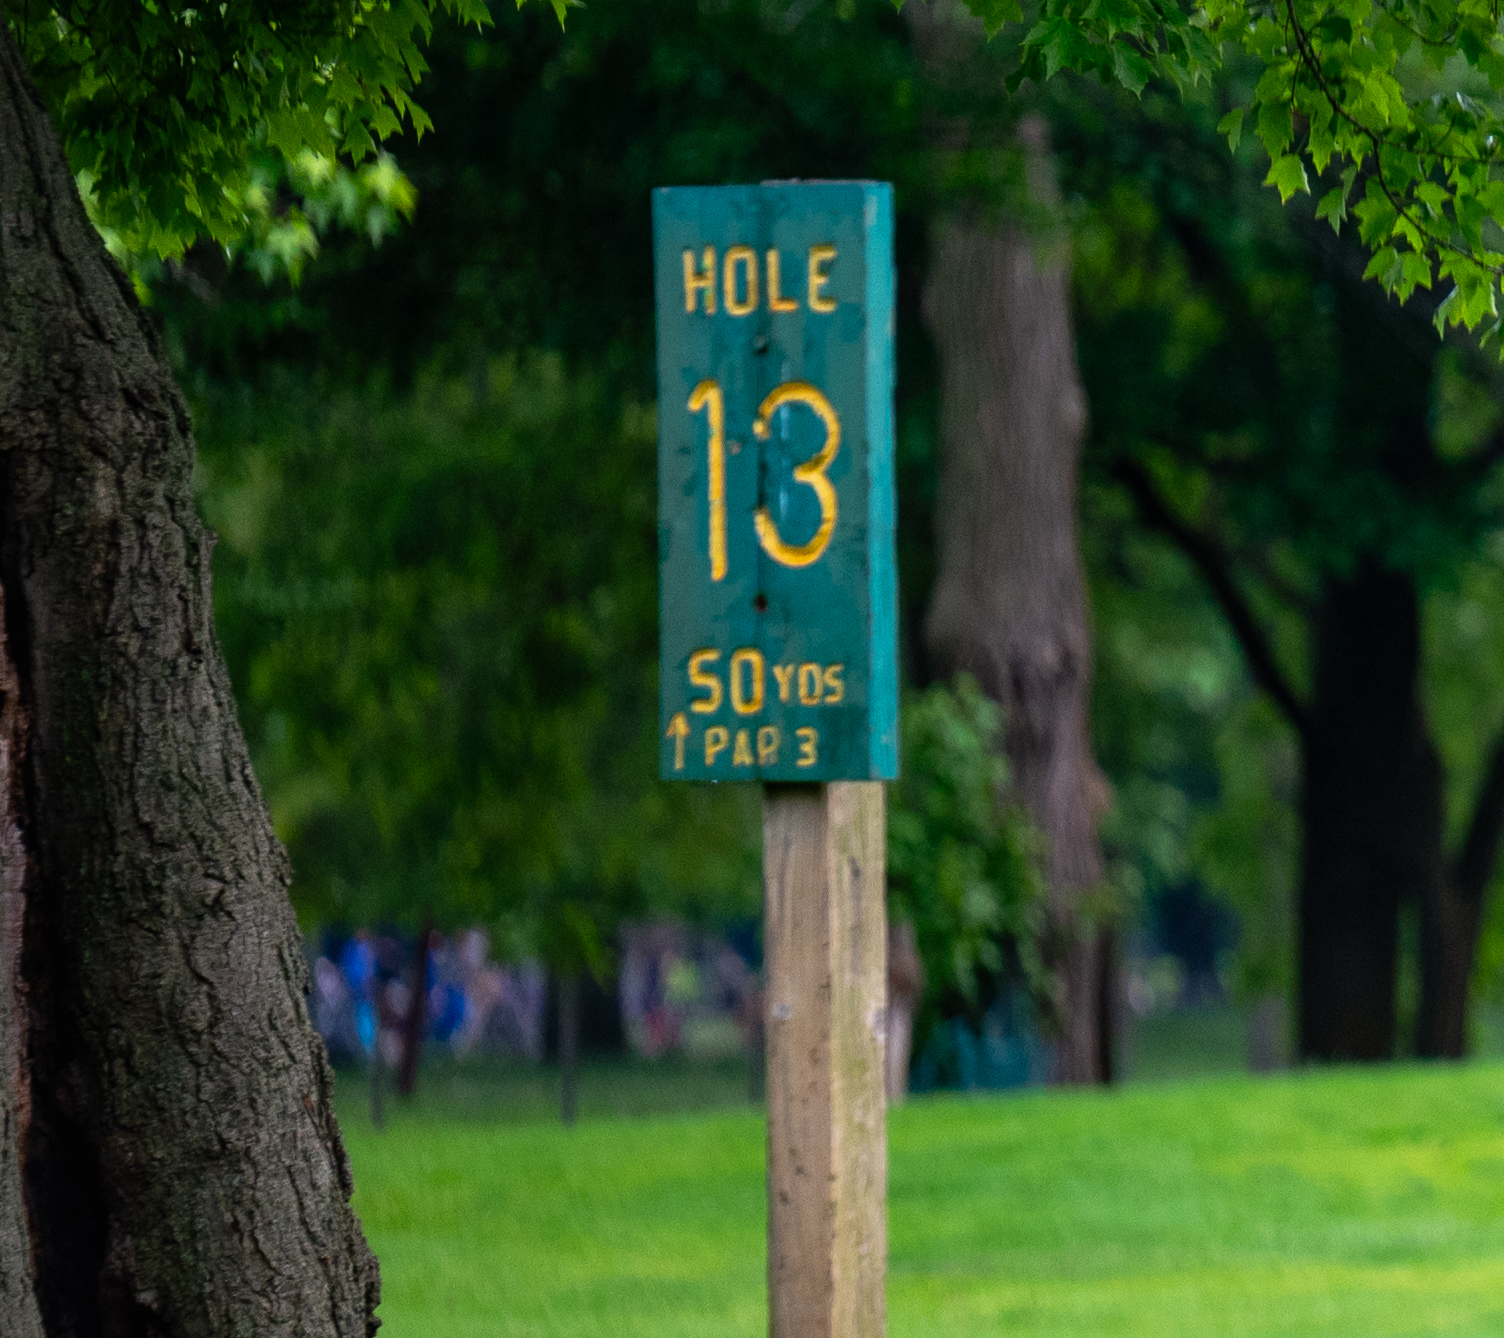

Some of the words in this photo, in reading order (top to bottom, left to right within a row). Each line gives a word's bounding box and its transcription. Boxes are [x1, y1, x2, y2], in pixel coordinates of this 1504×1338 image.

[682, 246, 838, 316] HOLE
[688, 380, 842, 582] 13
[688, 647, 766, 715] 50
[774, 663, 846, 705] YDS
[705, 726, 780, 767] PAR
[796, 727, 820, 767] 3
